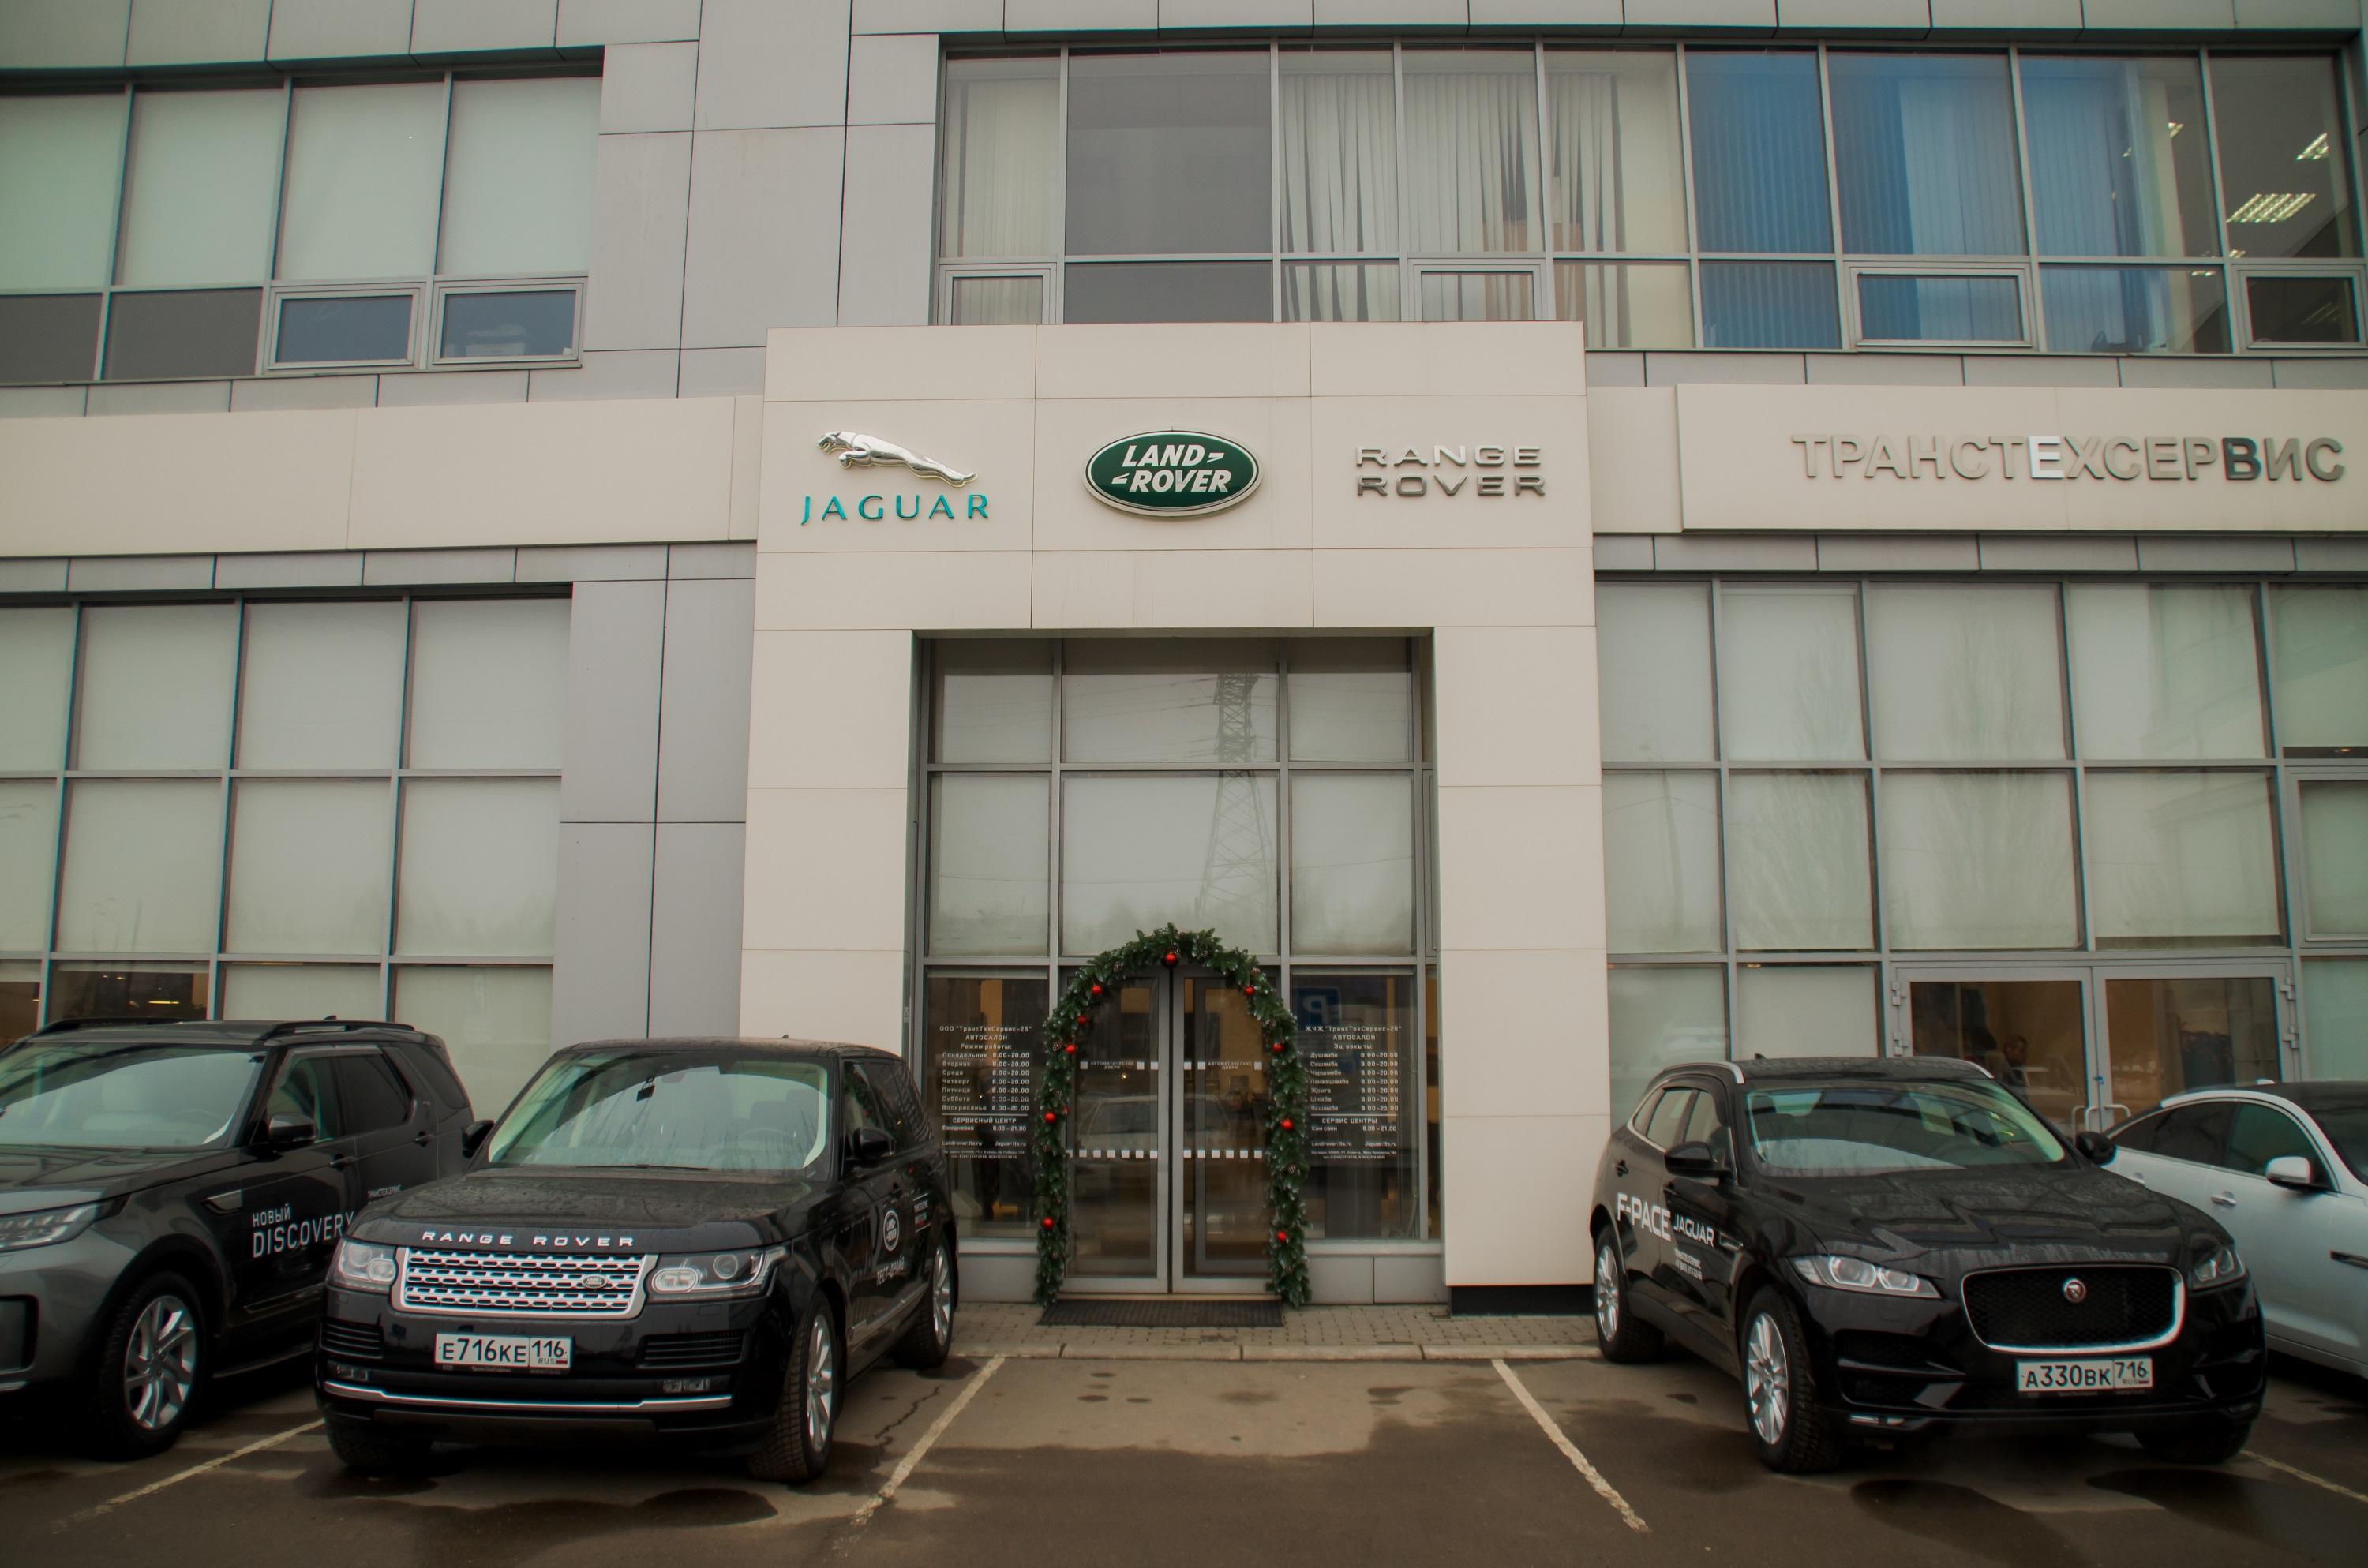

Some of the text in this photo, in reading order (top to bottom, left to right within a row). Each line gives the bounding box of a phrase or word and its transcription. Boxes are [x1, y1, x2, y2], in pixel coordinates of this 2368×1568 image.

[1122, 444, 1205, 467] LAND
[1356, 445, 1541, 467] RANGE
[1793, 435, 2344, 481] ТРАНСТЕХСЕРВИС
[1129, 470, 1231, 493] ROVER
[1357, 473, 1546, 496] ROVER
[801, 495, 988, 526] JAGUAR
[252, 1203, 290, 1228] НОВЫЙ
[1617, 1192, 1672, 1242] F-PACE
[253, 1211, 354, 1259] DISCOVERY
[422, 1231, 634, 1247] RANGE ROVER
[1673, 1214, 1714, 1248] JAGUAR
[532, 1340, 564, 1357] 116
[2115, 1361, 2149, 1379] 716
